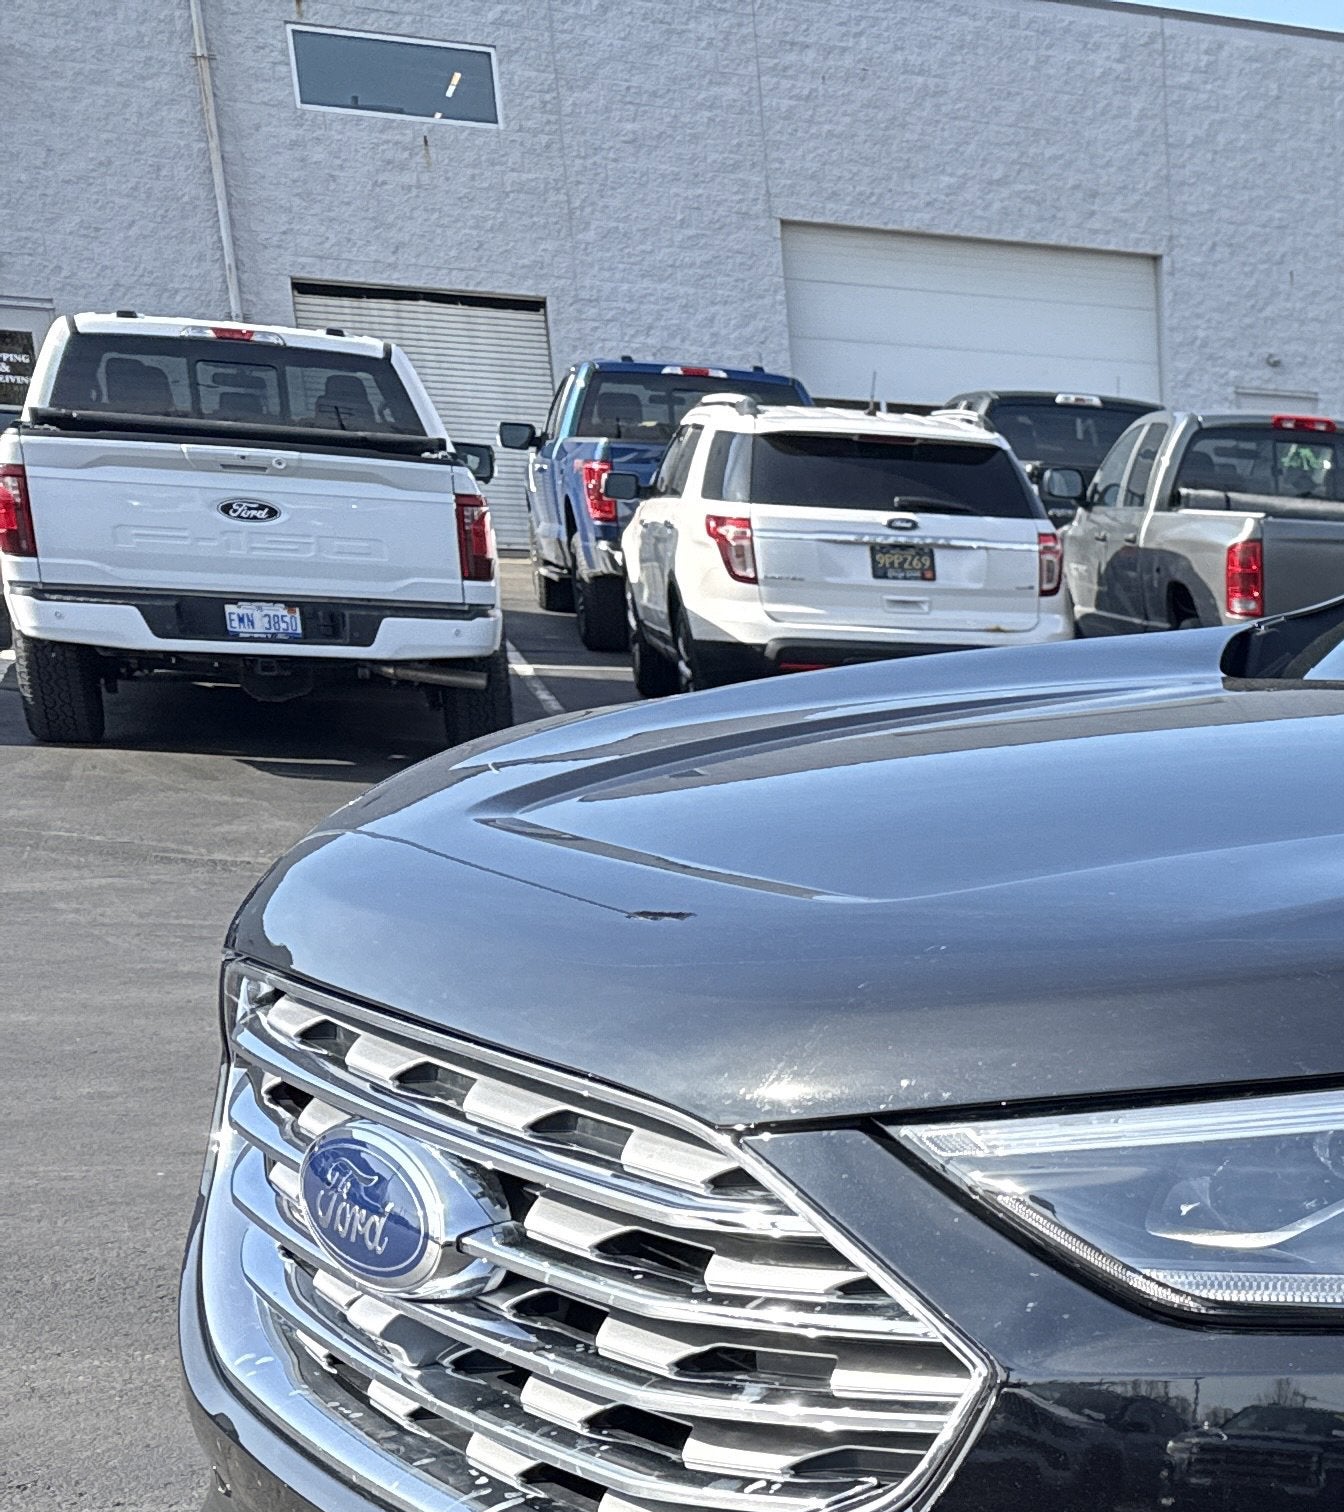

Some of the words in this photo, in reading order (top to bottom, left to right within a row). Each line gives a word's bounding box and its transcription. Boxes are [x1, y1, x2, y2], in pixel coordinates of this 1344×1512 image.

[228, 501, 270, 520] Ford
[113, 524, 389, 562] F-150
[263, 613, 298, 632] 3850
[315, 1156, 396, 1255] Ford
